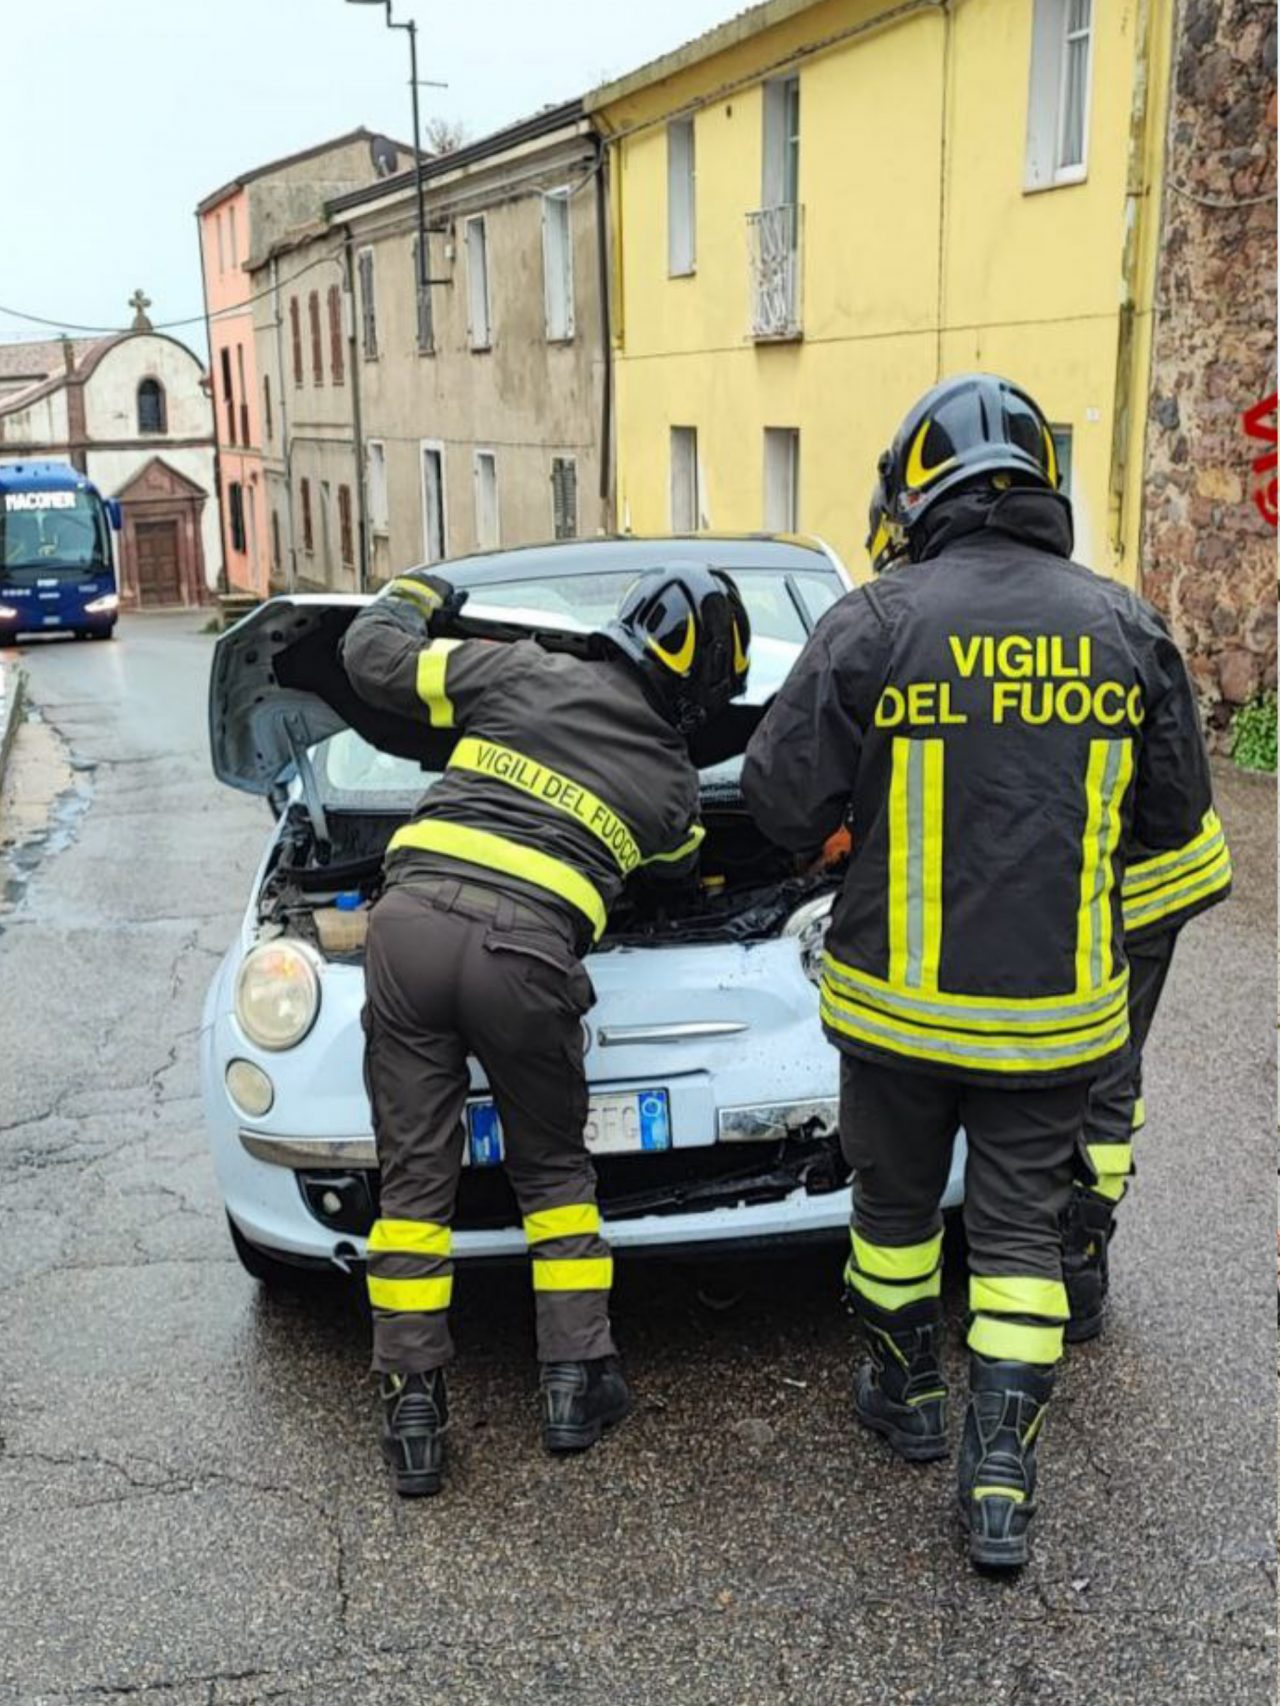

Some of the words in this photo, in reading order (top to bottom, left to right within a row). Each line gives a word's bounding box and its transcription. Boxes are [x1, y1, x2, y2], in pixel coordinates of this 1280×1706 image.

[949, 635, 1091, 678] VIGILI
[874, 682, 968, 727] DEL
[476, 744, 541, 787] VIGILI
[542, 775, 586, 817] DEL
[590, 806, 639, 869] FUOCO
